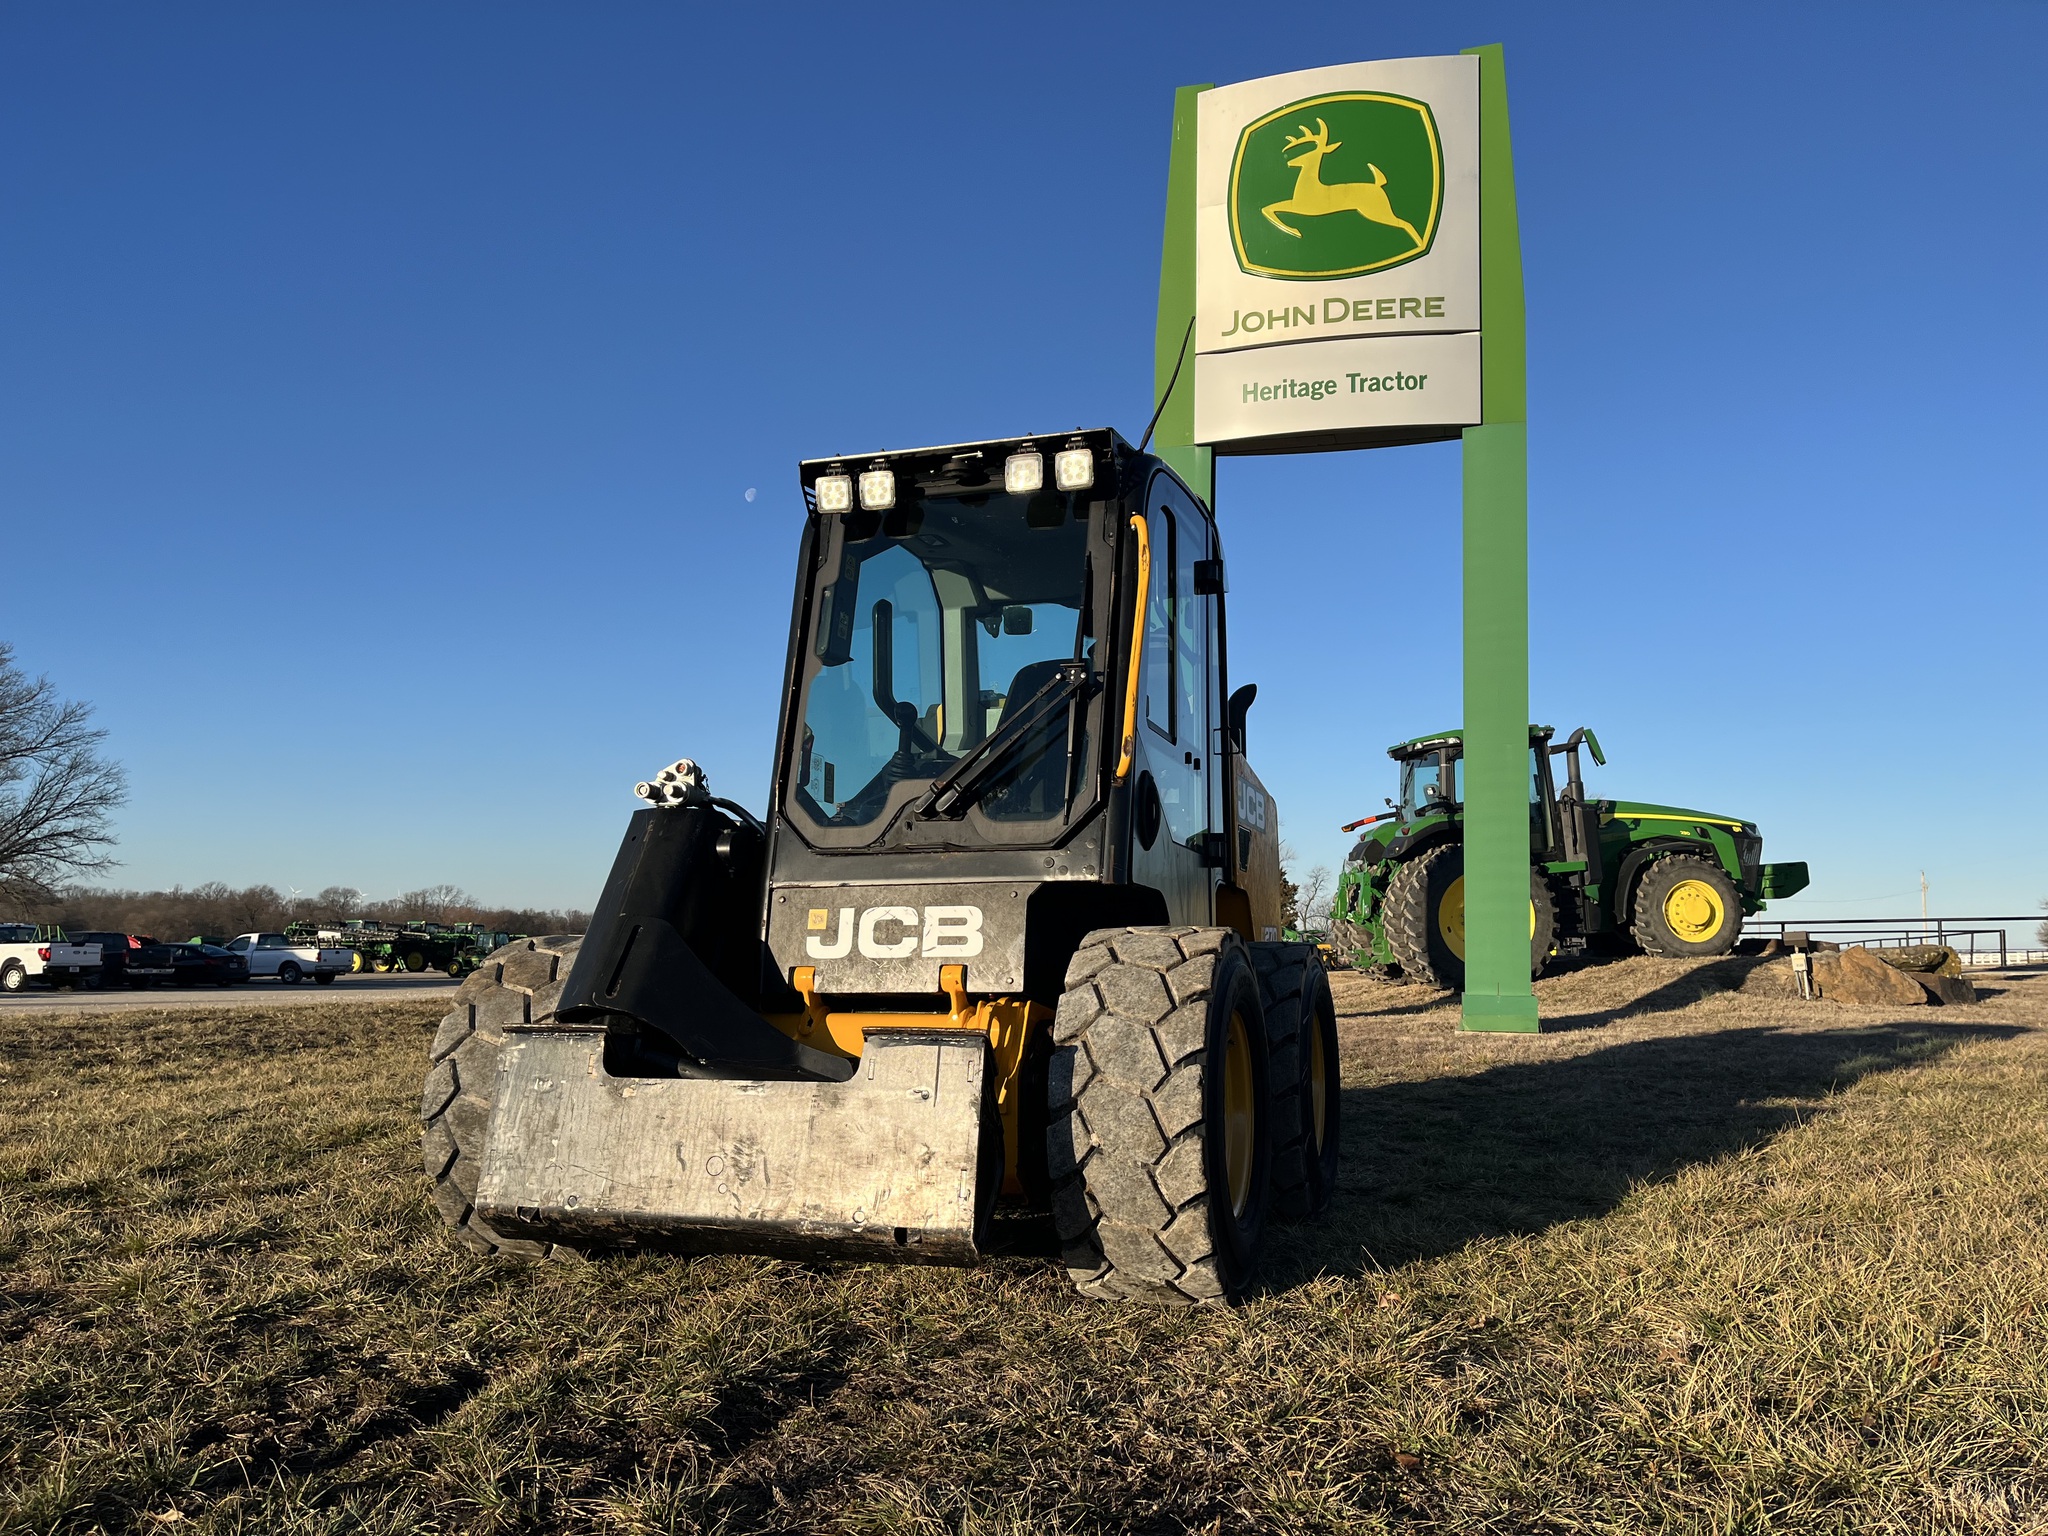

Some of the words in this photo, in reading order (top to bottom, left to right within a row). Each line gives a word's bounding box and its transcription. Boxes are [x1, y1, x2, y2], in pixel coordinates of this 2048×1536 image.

[1221, 304, 1315, 337] JOHN
[1323, 296, 1445, 324] DEERE
[1242, 378, 1338, 404] Heritage
[1345, 371, 1428, 394] Tractor
[1238, 780, 1265, 830] JCB
[806, 906, 983, 959] JCB
